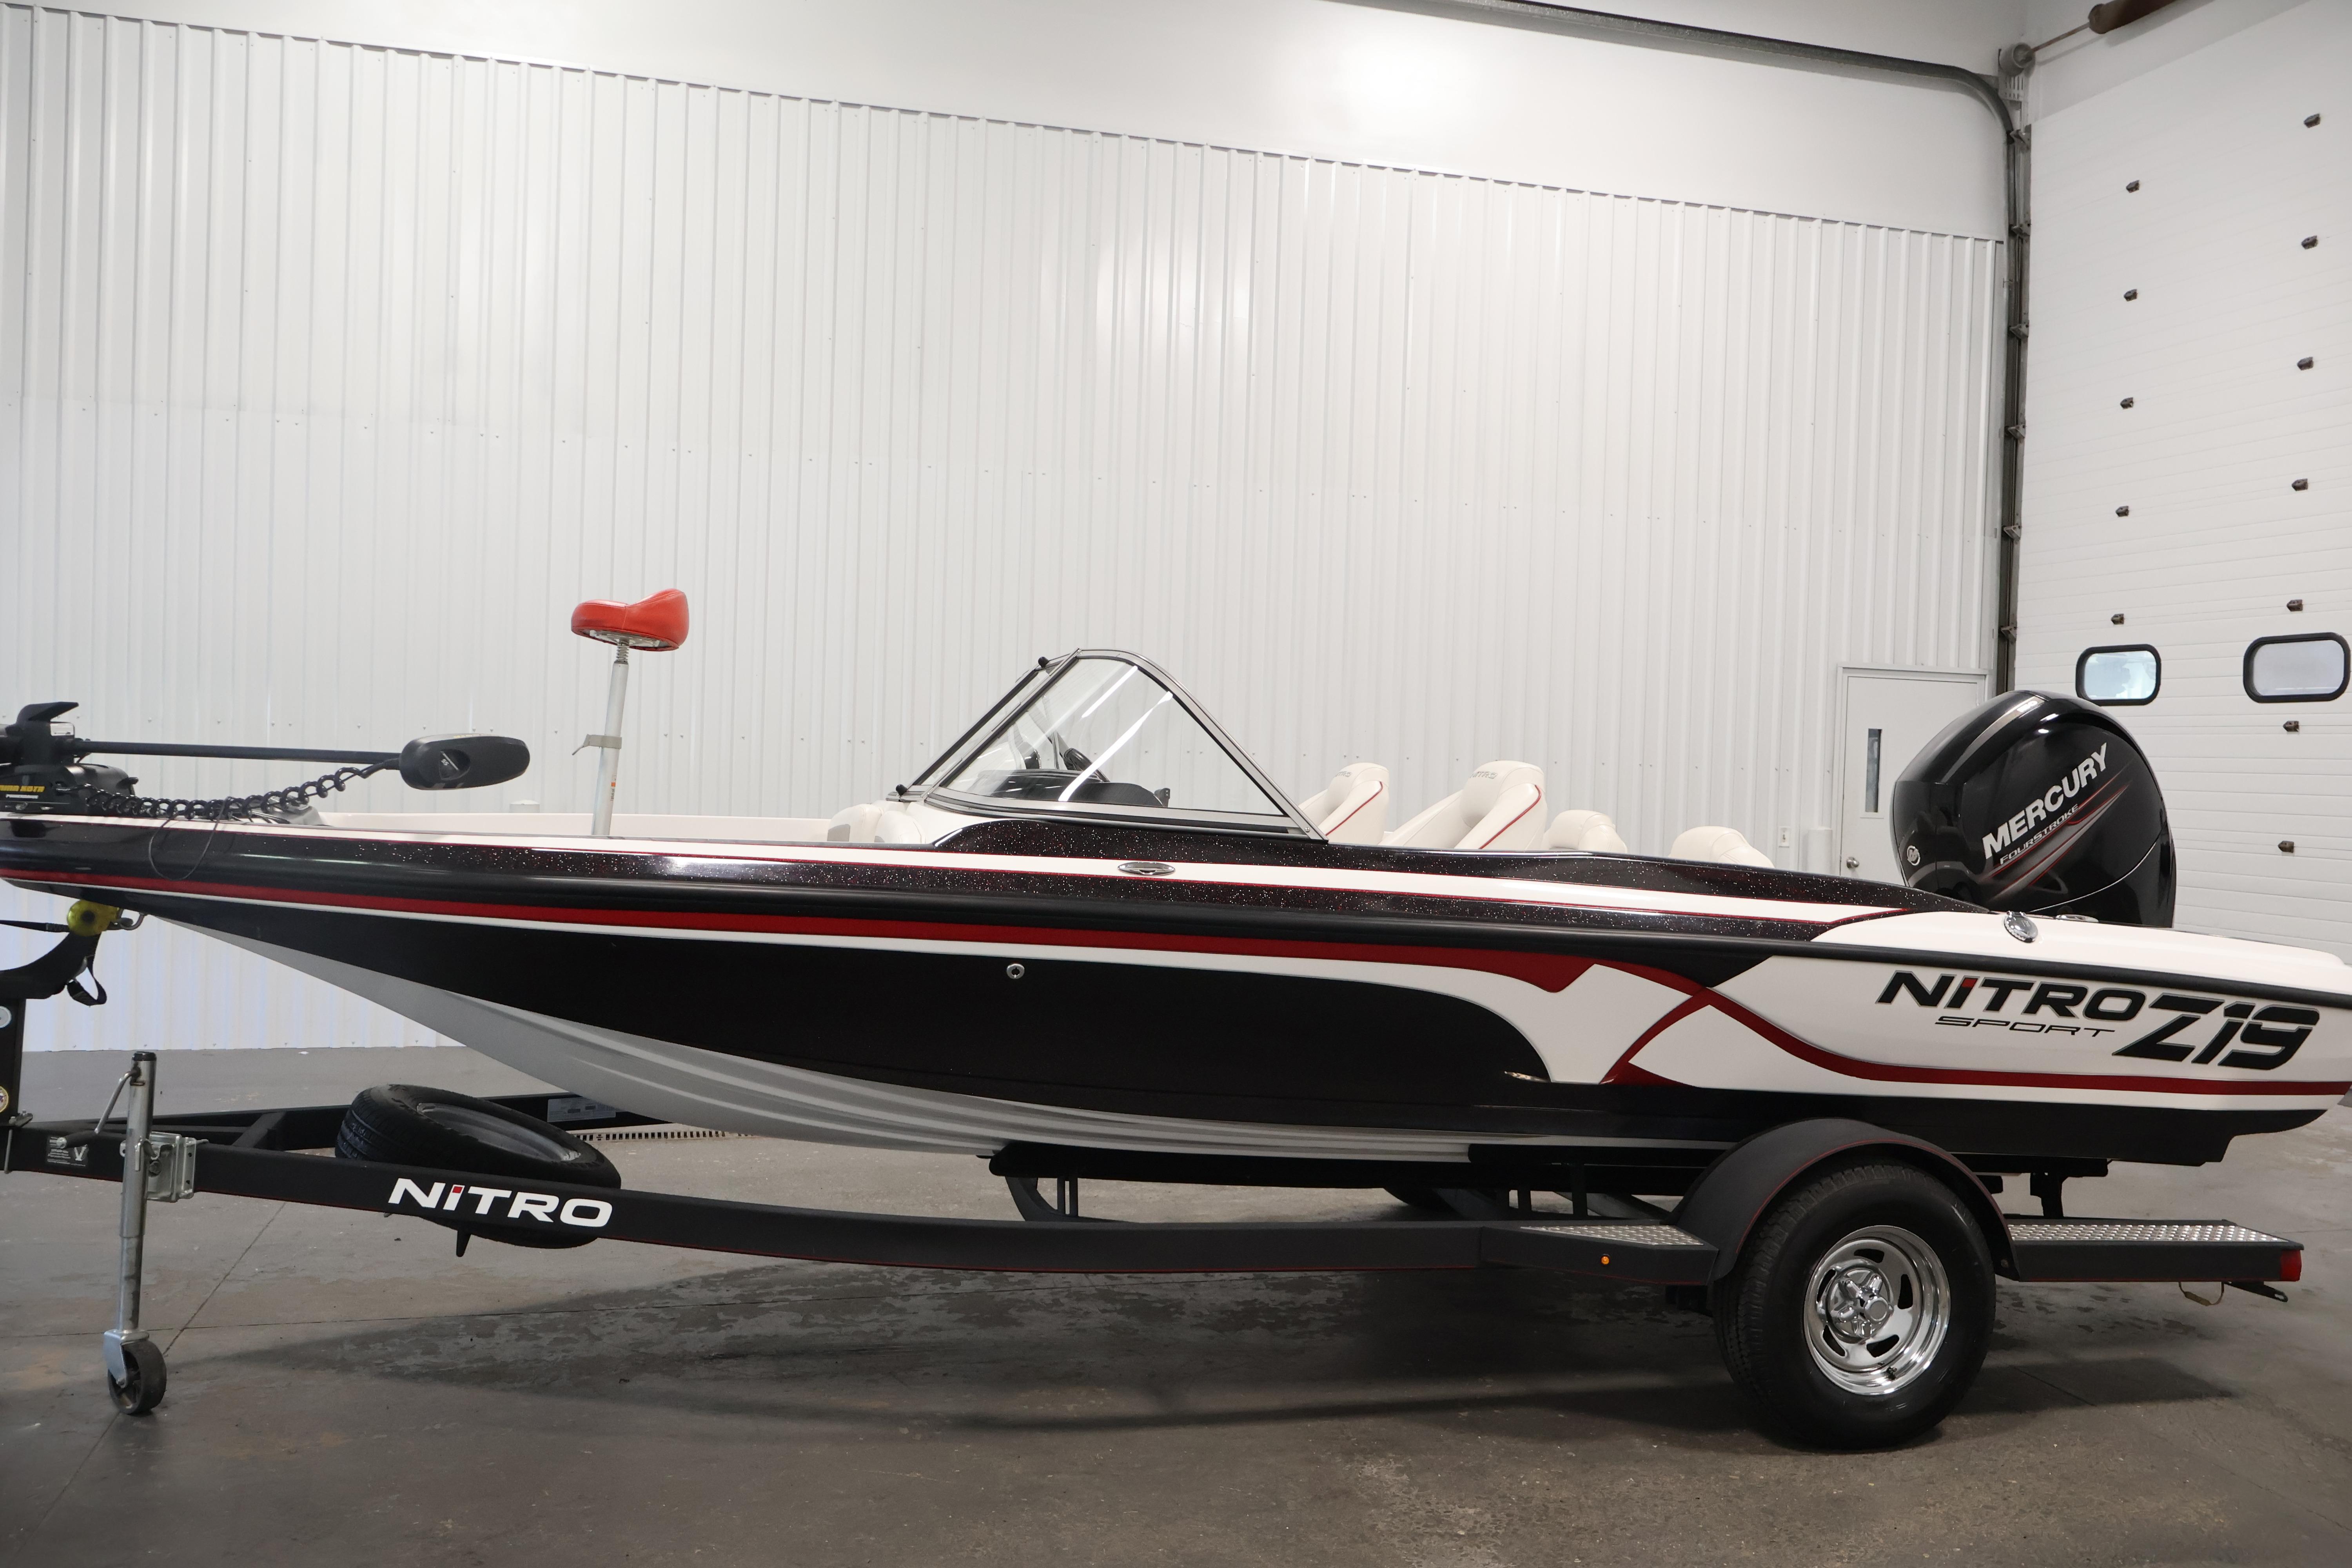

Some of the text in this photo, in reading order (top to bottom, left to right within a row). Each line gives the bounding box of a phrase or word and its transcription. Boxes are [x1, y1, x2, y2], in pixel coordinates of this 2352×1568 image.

[1982, 742, 2107, 859] MERCURY
[2000, 804, 2079, 865] FOURSTROKE
[1875, 970, 2320, 1071] NITRO Z19
[1935, 1016, 2116, 1037] SPORT
[388, 1178, 612, 1227] NITRO
